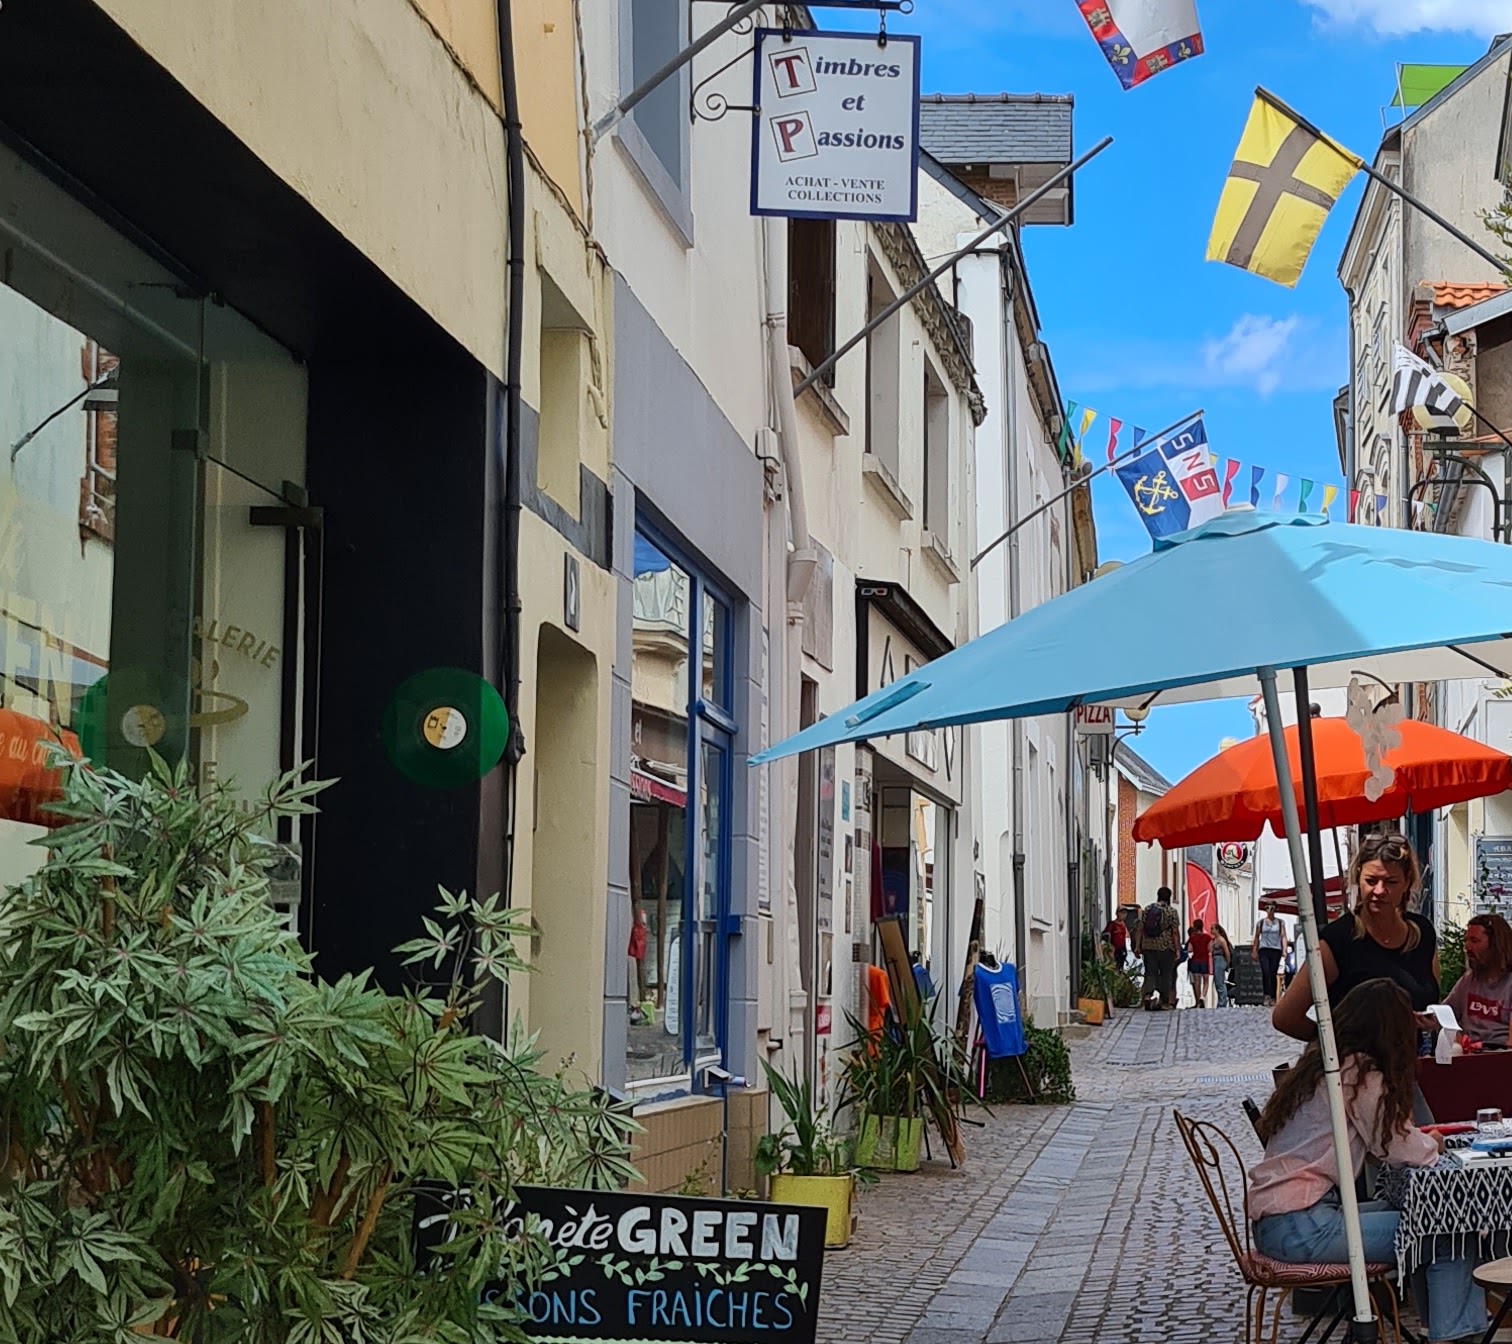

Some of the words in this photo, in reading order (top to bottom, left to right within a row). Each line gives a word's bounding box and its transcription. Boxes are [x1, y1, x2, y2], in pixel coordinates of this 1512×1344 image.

[774, 54, 901, 89] Timbres
[842, 94, 865, 111] et
[776, 118, 905, 154] Passions
[785, 176, 830, 188] ACHAT
[842, 178, 885, 190] VENTE
[788, 190, 882, 203] COLLECTIONS
[192, 616, 281, 670] ALERIE
[1076, 704, 1111, 724] PIZZA
[617, 1206, 800, 1261] GREEN
